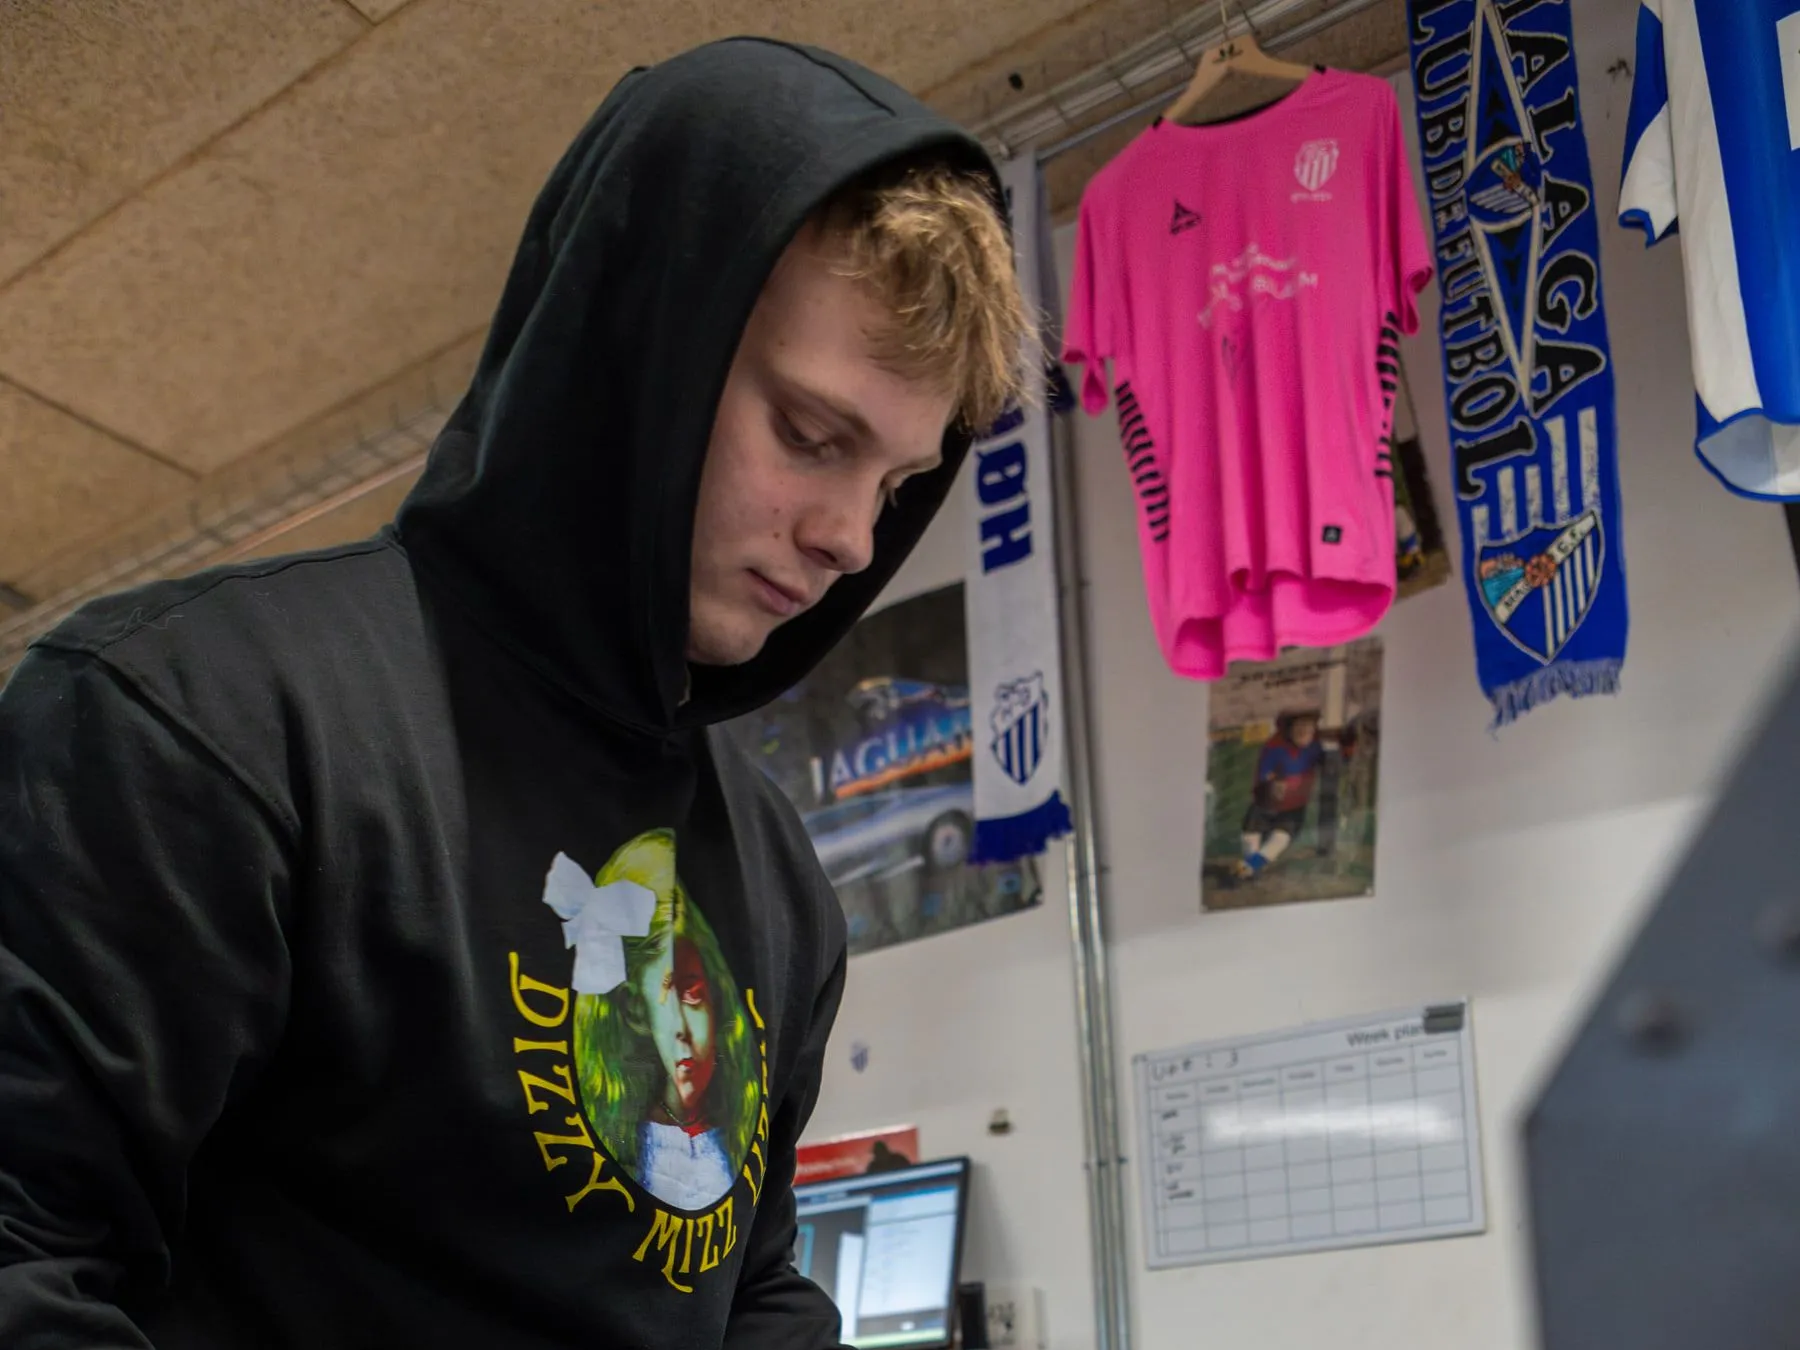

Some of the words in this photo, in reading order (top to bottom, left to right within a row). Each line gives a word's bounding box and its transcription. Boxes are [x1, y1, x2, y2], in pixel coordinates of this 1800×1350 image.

[1426, 153, 1469, 234] DE
[1436, 226, 1537, 501] FUTBOL
[508, 950, 636, 1213] DIZZY
[632, 1195, 737, 1294] MIZZ
